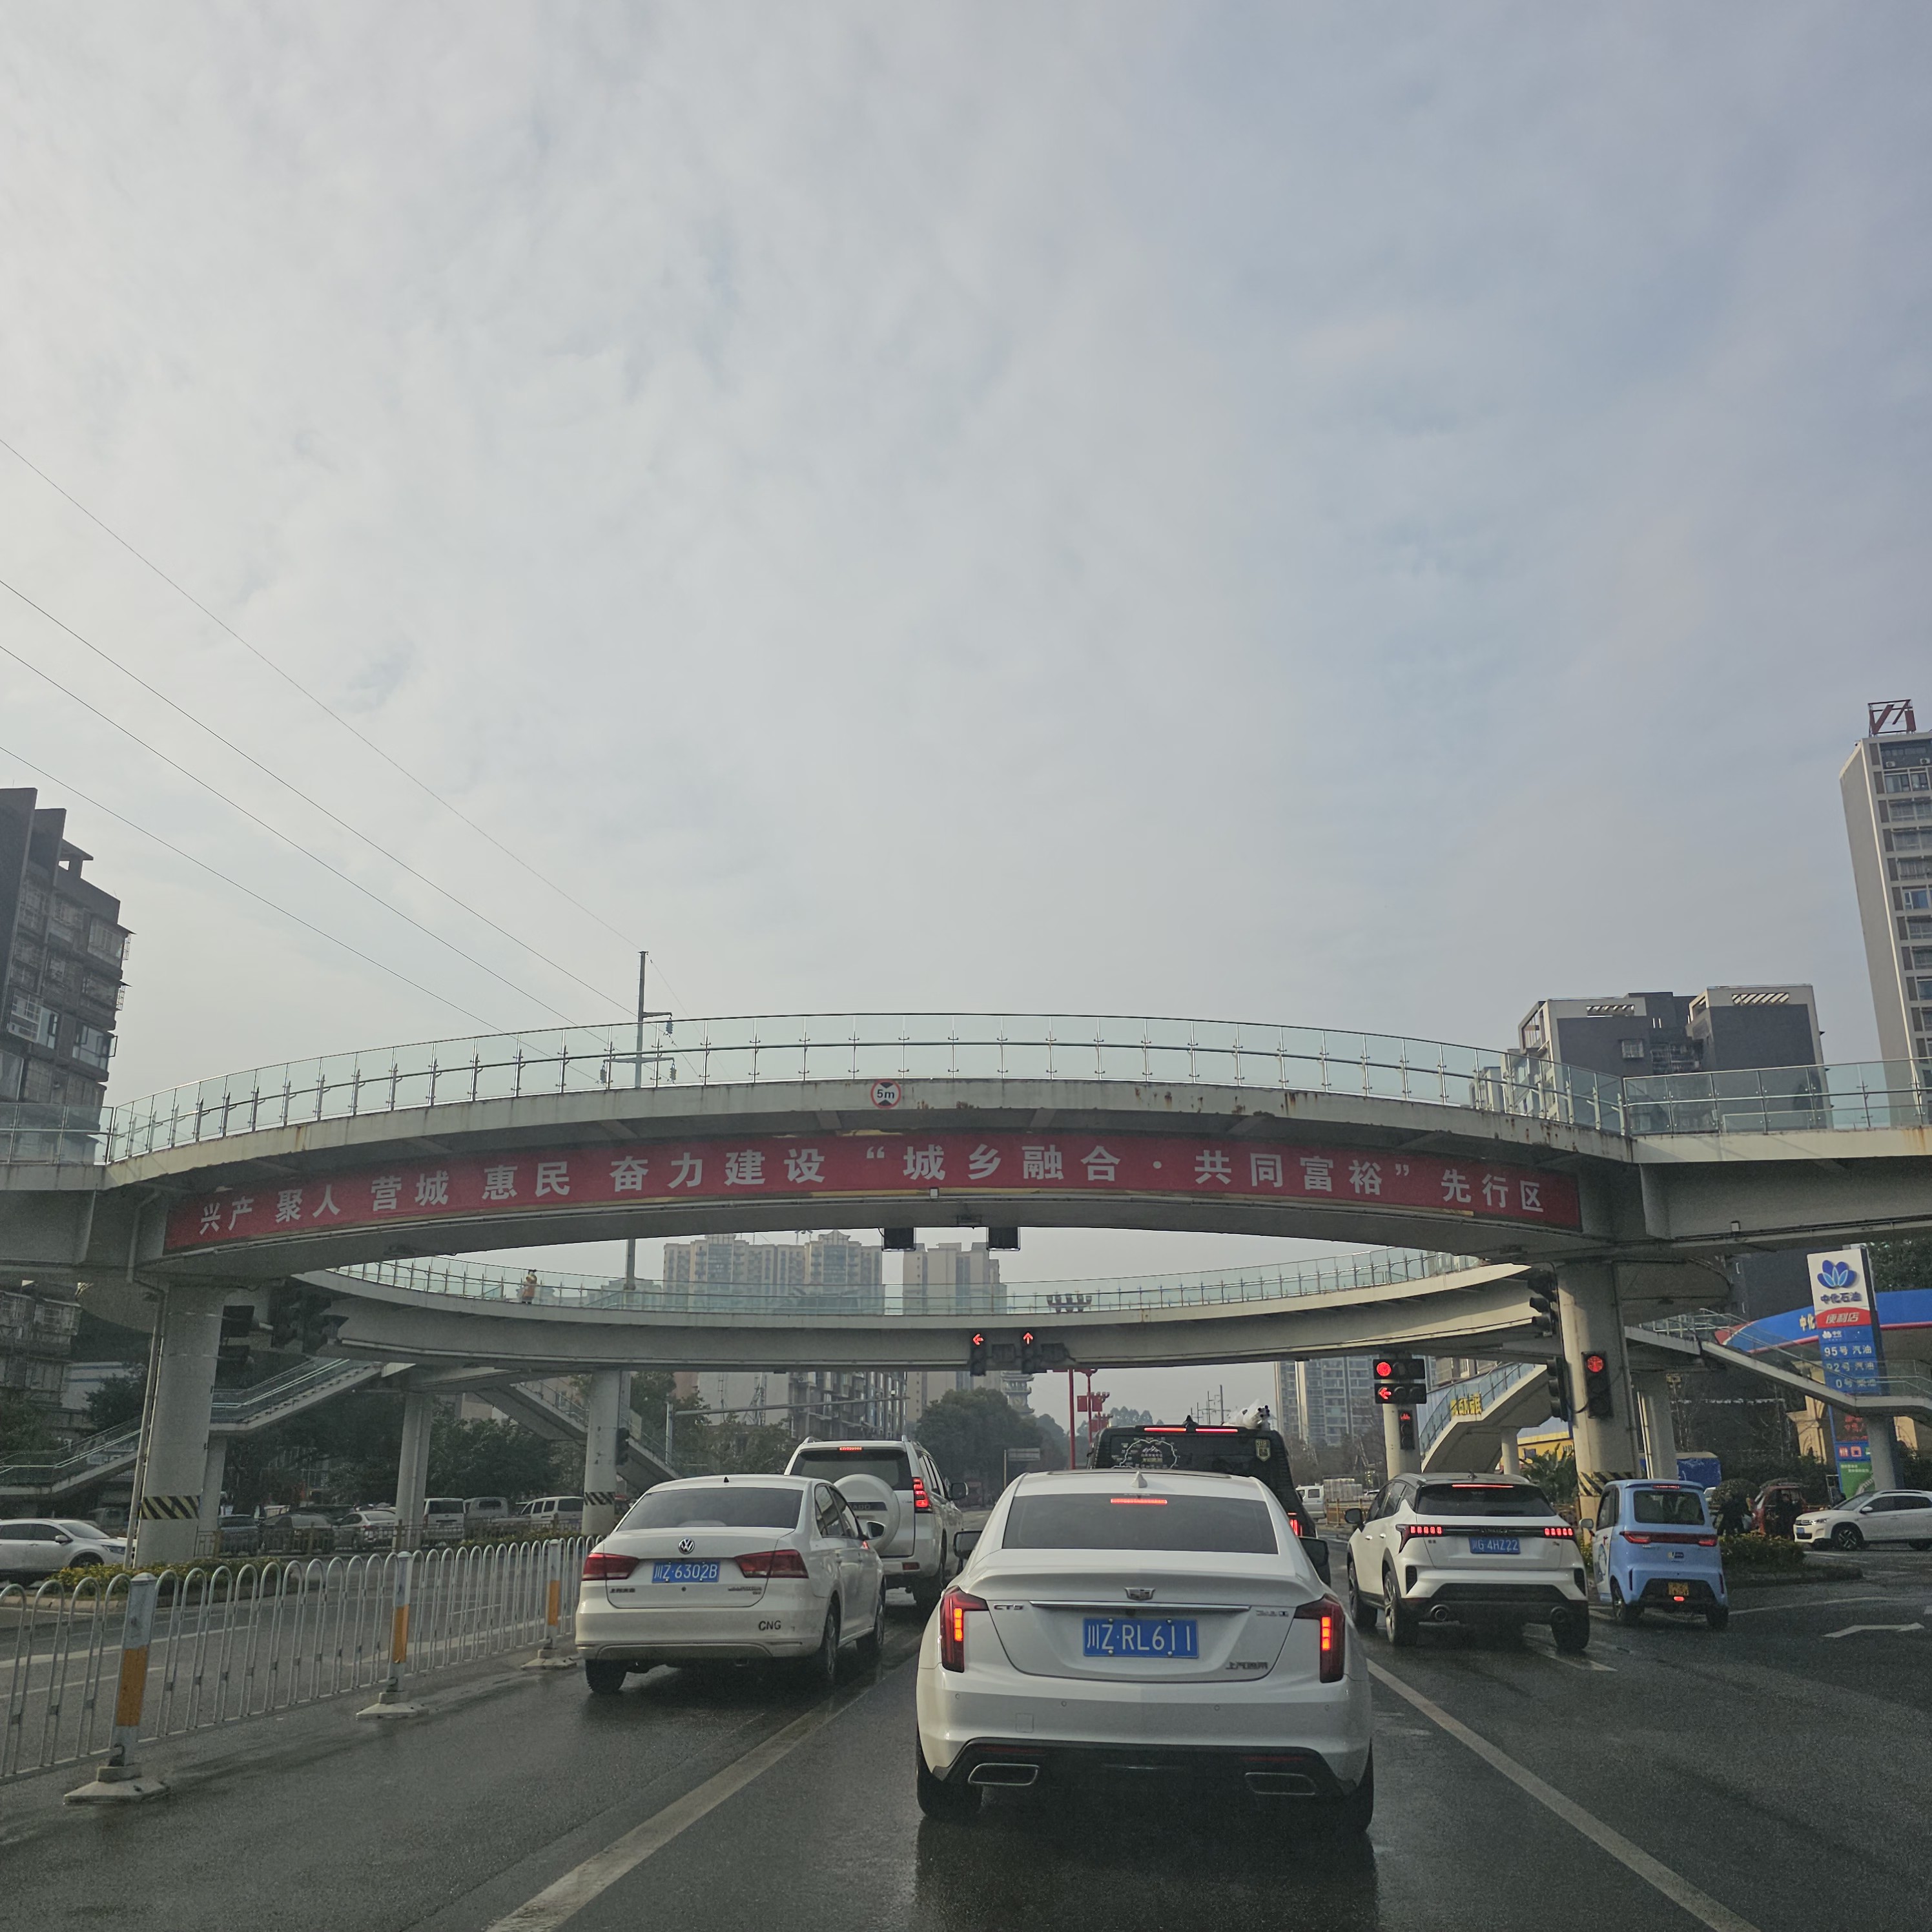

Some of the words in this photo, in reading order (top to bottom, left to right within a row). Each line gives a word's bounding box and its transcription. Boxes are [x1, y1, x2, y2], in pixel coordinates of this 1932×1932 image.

[877, 1089, 895, 1099] 5m
[610, 1148, 825, 1192] 奋力建设
[1441, 1169, 1544, 1213] 先行区
[1820, 1291, 1862, 1304] 中化石油
[1826, 1312, 1860, 1324] 便利店
[1824, 1346, 1847, 1356] 95号
[1853, 1345, 1872, 1354] 汽油
[758, 1620, 781, 1631] CNG
